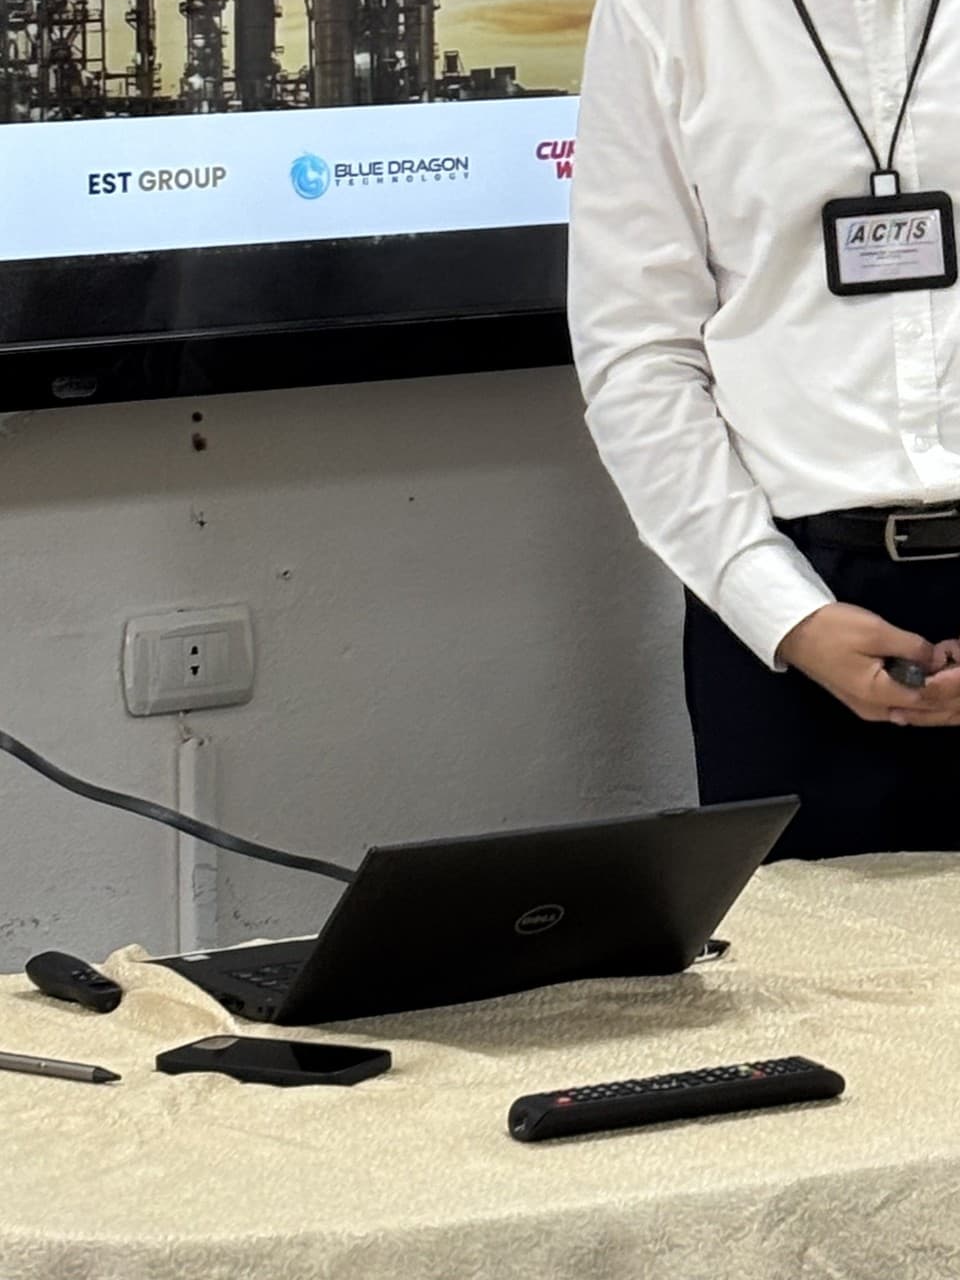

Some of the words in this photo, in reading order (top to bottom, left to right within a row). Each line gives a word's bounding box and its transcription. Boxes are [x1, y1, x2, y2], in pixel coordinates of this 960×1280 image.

[334, 161, 384, 178] BLUE
[388, 156, 469, 175] DRAGON
[88, 172, 132, 195] EST
[138, 166, 227, 191] GROUP
[335, 172, 470, 187] TECHNOLOGY
